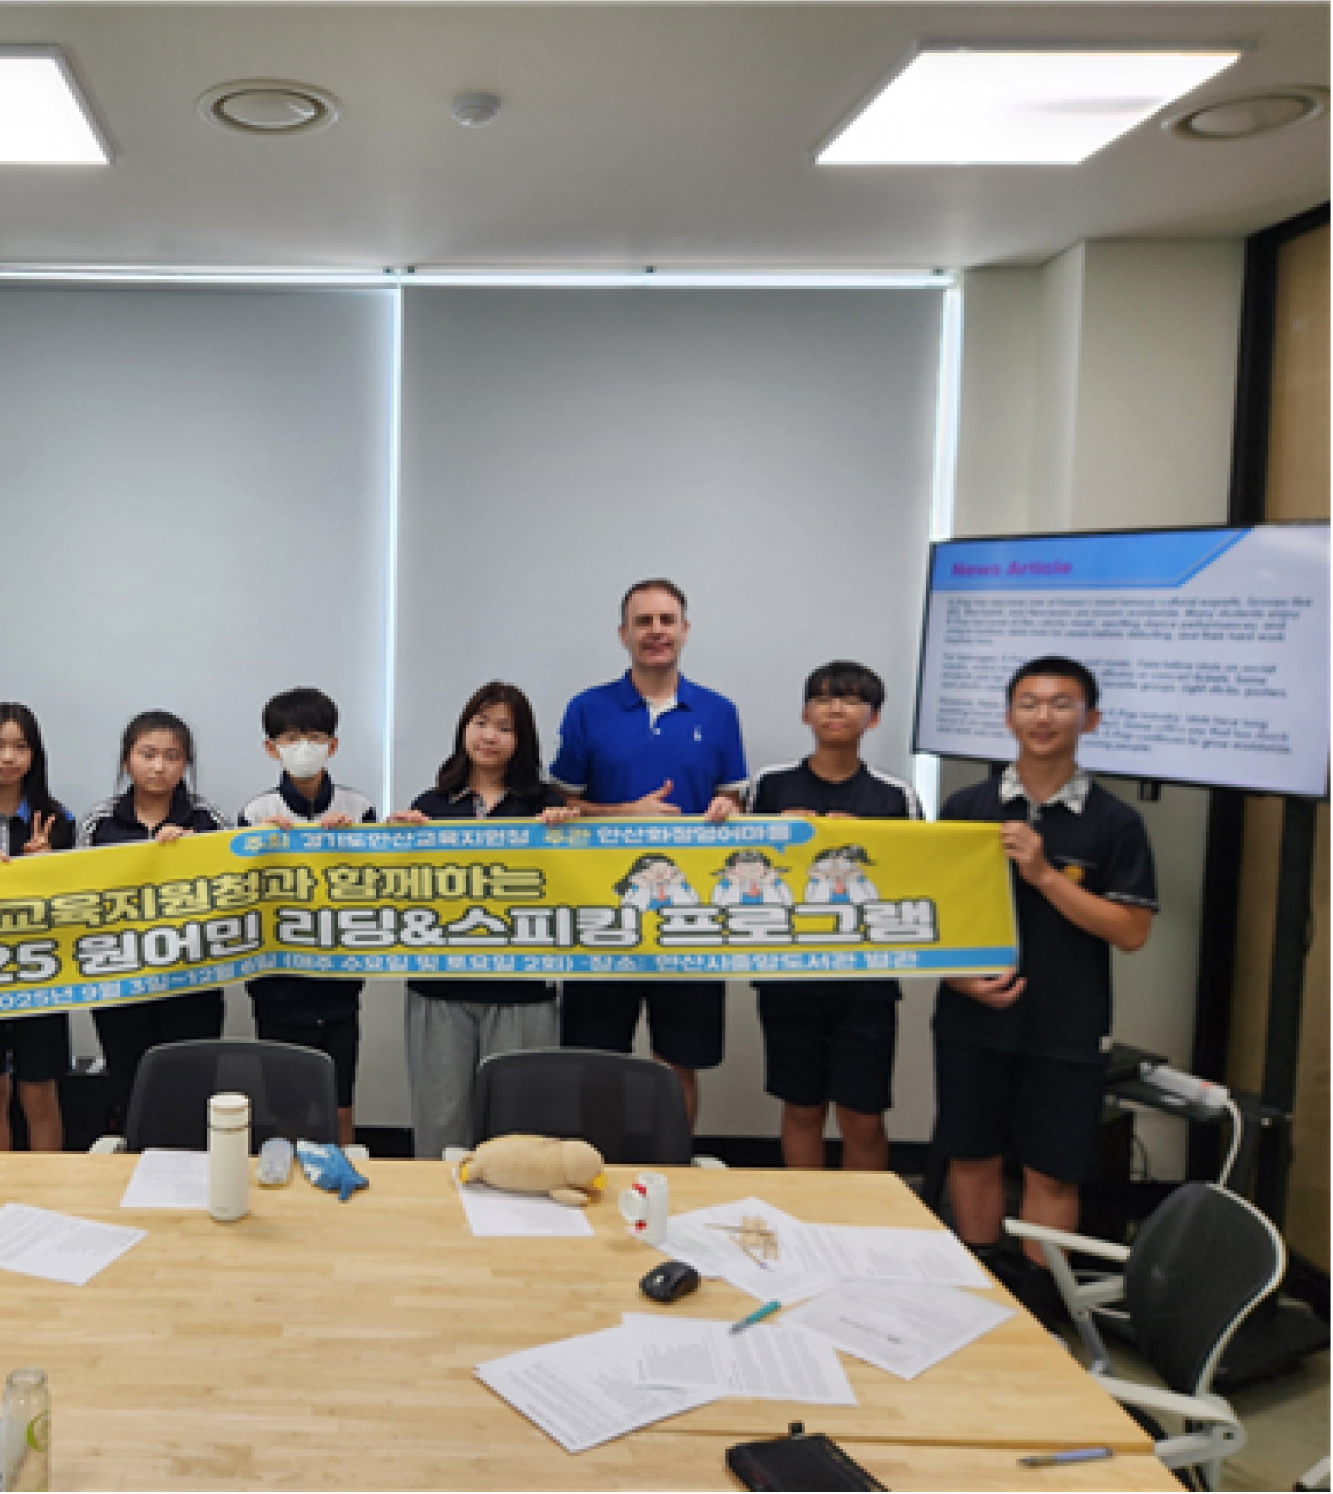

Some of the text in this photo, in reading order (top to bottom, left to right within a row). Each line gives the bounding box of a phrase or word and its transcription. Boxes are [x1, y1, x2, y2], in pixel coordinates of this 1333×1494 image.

[953, 560, 1073, 576] News Article
[328, 864, 546, 902] 함께하는
[74, 911, 263, 977] 원어민
[275, 904, 642, 949] 리딩&스피킹
[656, 898, 939, 946] 프로그램
